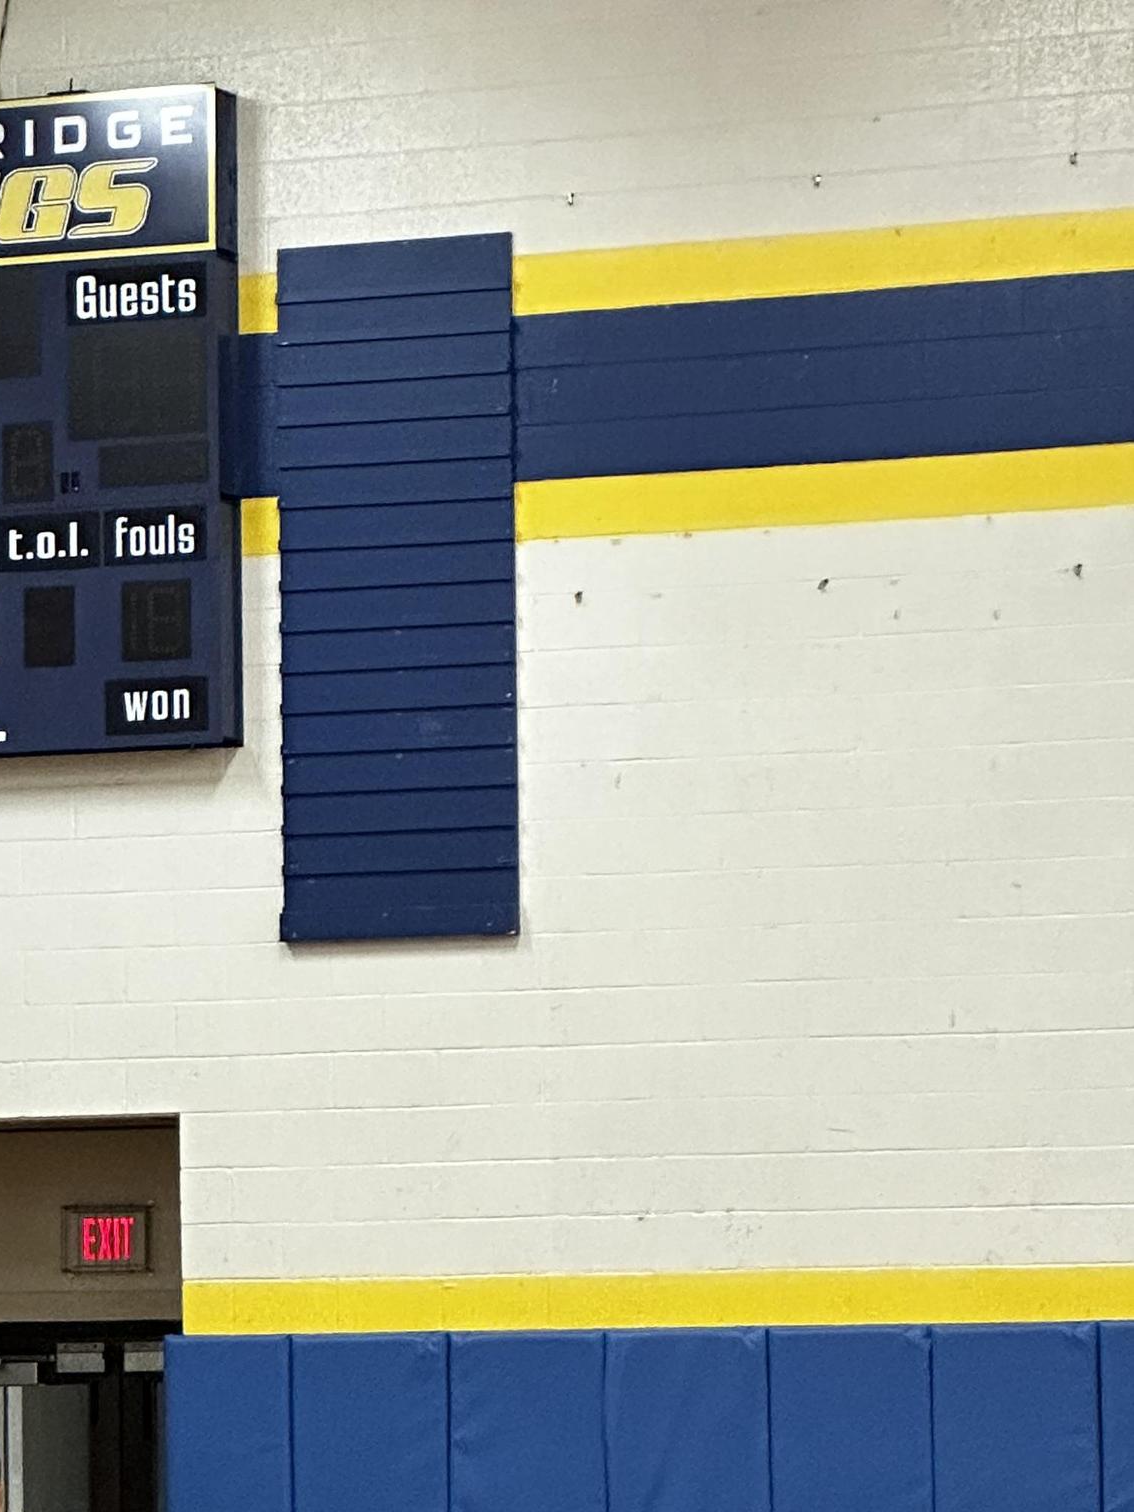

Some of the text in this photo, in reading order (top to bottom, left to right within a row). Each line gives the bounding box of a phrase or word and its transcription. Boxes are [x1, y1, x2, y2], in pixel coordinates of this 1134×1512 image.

[75, 273, 197, 320] Guests
[8, 521, 89, 561] t.o.l.
[115, 514, 195, 558] fouls
[123, 688, 190, 722] won
[83, 1217, 134, 1260] EXIT
